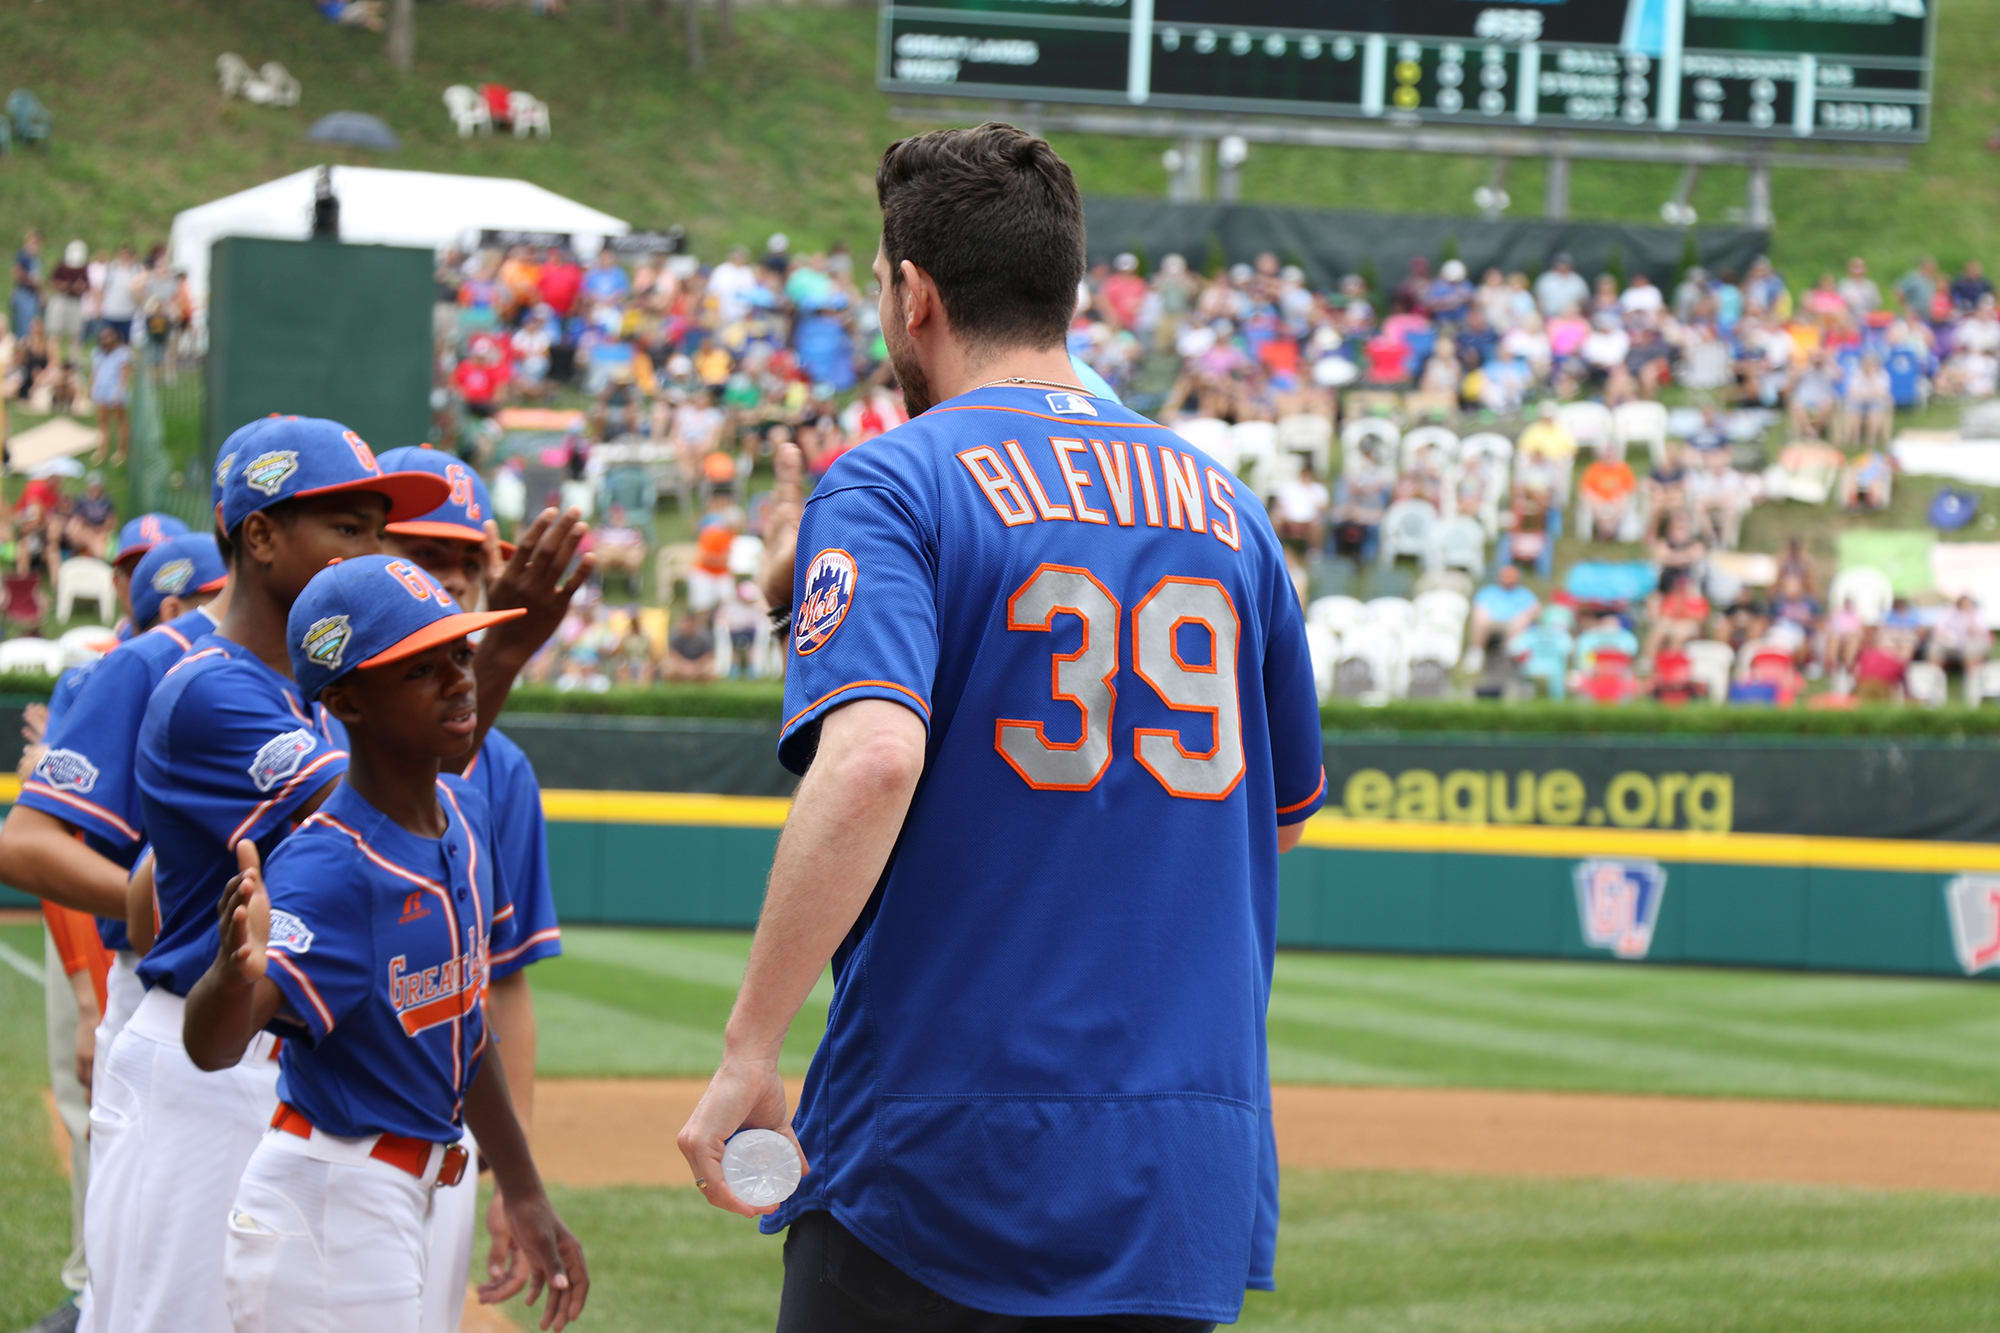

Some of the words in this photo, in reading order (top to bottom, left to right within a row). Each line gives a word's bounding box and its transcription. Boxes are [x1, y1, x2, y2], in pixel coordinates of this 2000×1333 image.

[956, 436, 1241, 552] BLEVINS
[799, 582, 842, 635] Mets
[994, 562, 1247, 802] 39
[1322, 768, 1735, 834] eague.org
[389, 954, 469, 1012] GREAT
